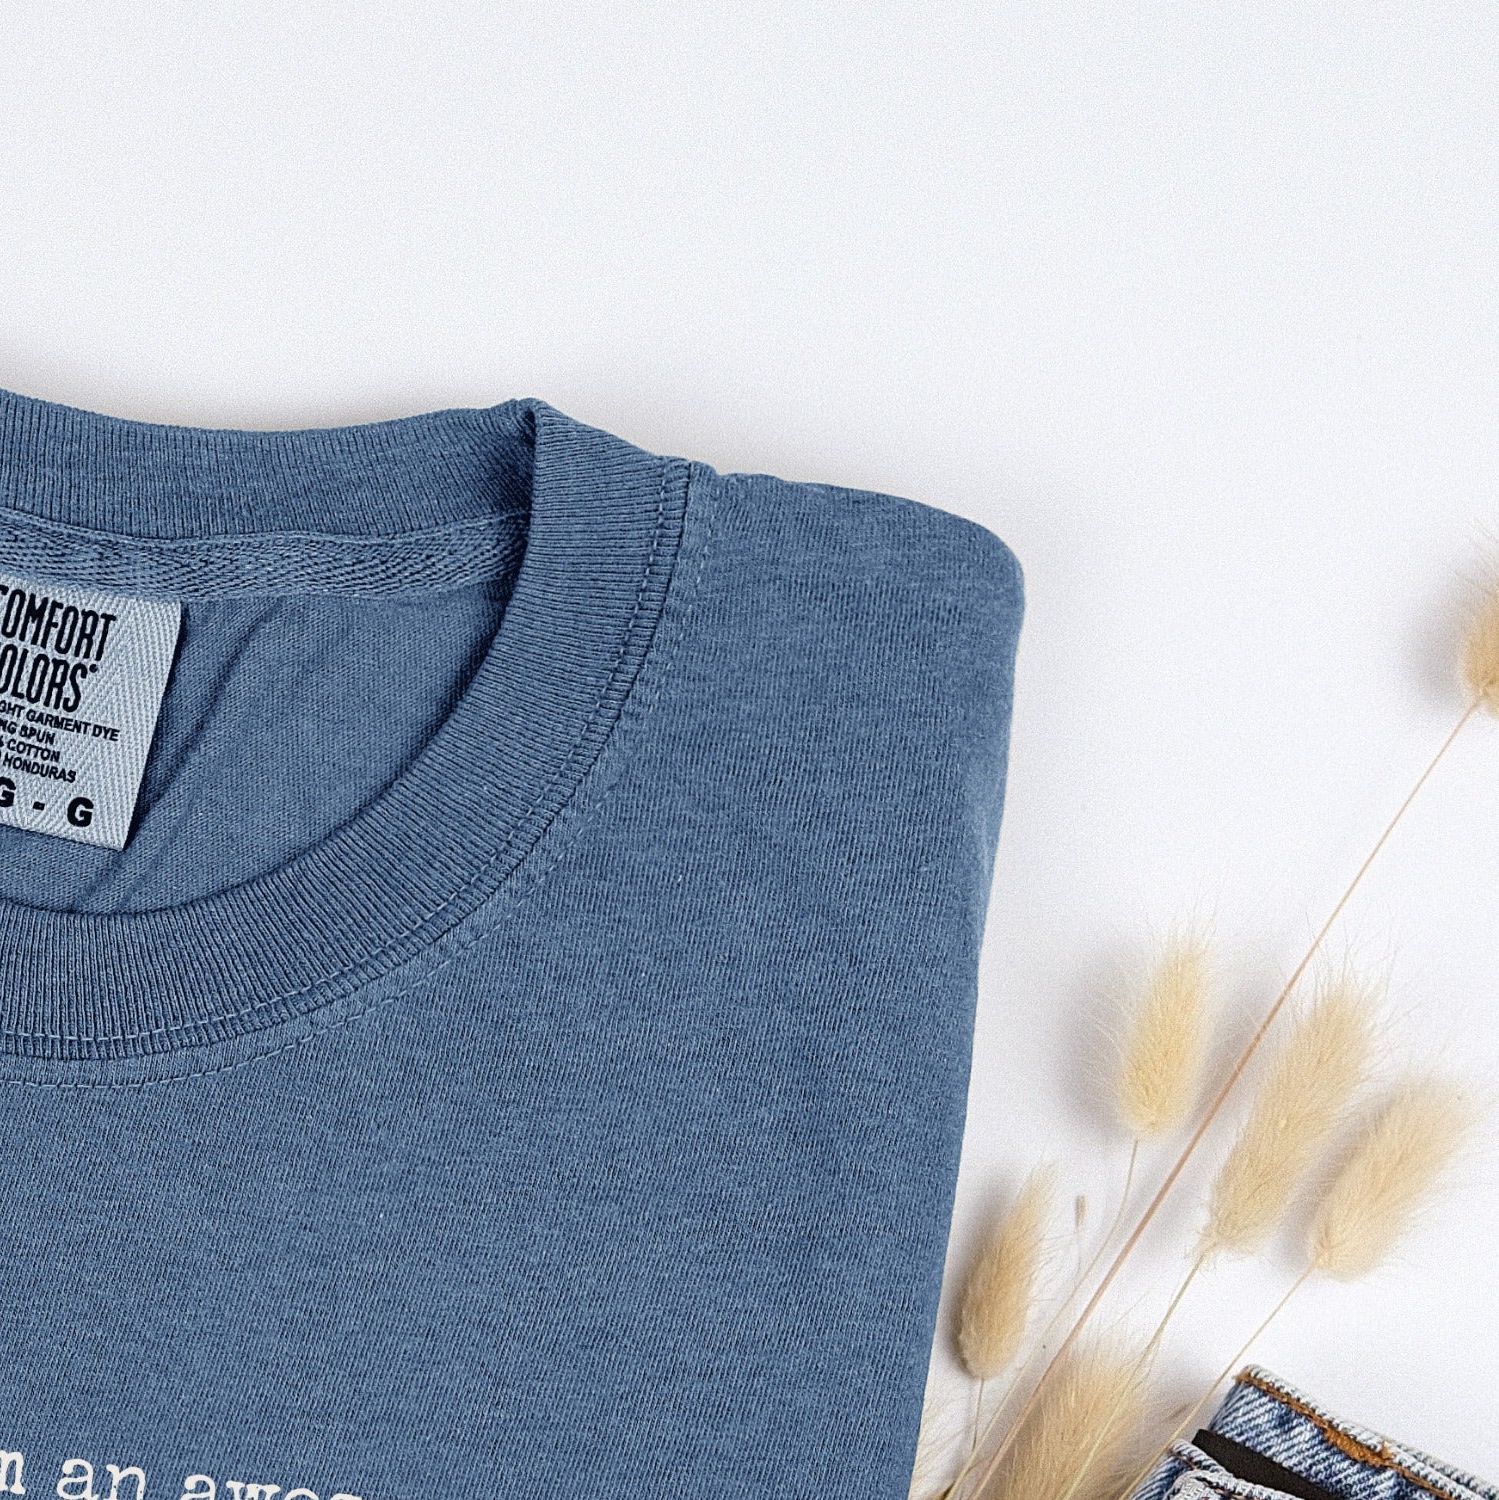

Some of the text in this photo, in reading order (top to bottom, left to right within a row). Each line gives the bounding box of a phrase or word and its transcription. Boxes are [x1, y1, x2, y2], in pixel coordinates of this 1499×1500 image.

[19, 724, 56, 745] SPUN
[26, 709, 91, 734] GARMENT
[92, 725, 120, 742] DYE
[6, 738, 60, 763] COTTON
[3, 752, 77, 784] HONDURAS
[67, 797, 94, 827] G
